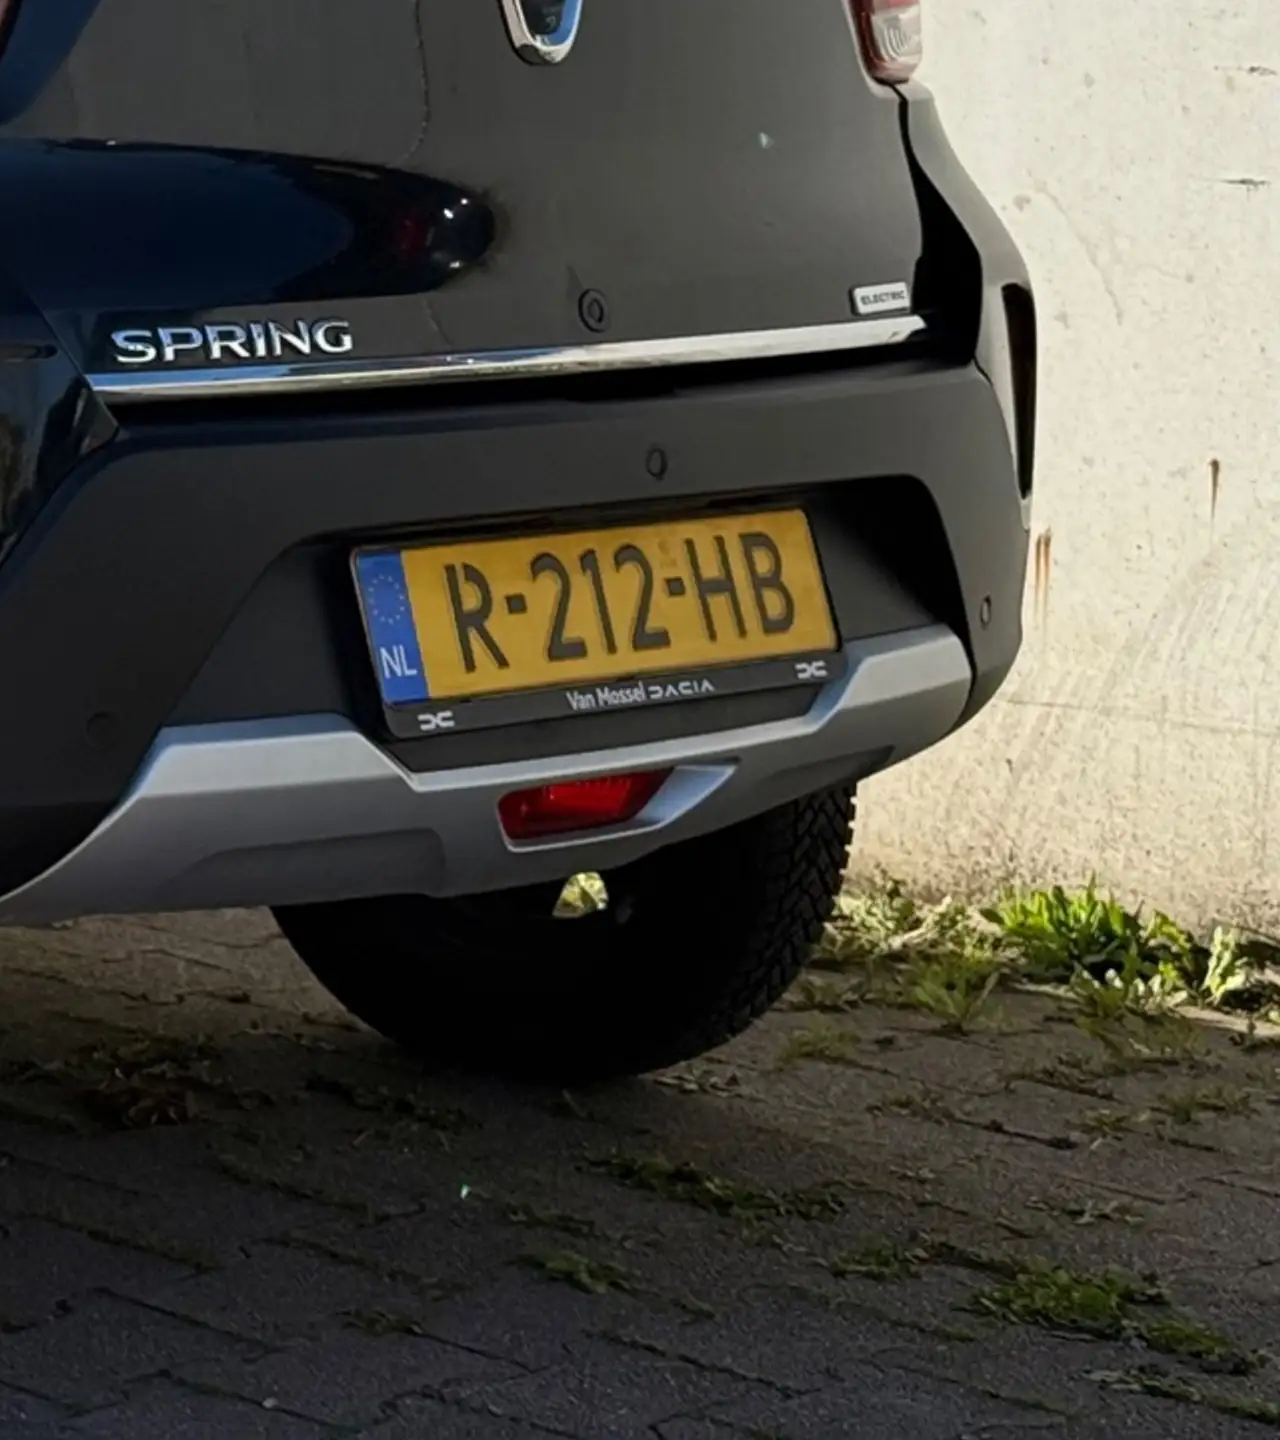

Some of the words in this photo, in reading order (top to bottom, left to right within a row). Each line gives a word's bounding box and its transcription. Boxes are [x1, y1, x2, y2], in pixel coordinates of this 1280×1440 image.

[860, 290, 906, 306] ELECTRIC
[111, 319, 354, 364] SPRING
[444, 531, 795, 674] R-212-HB
[379, 645, 418, 680] NL
[565, 689, 597, 711] Van
[595, 680, 646, 708] Mossel
[647, 678, 717, 700] DACIA
